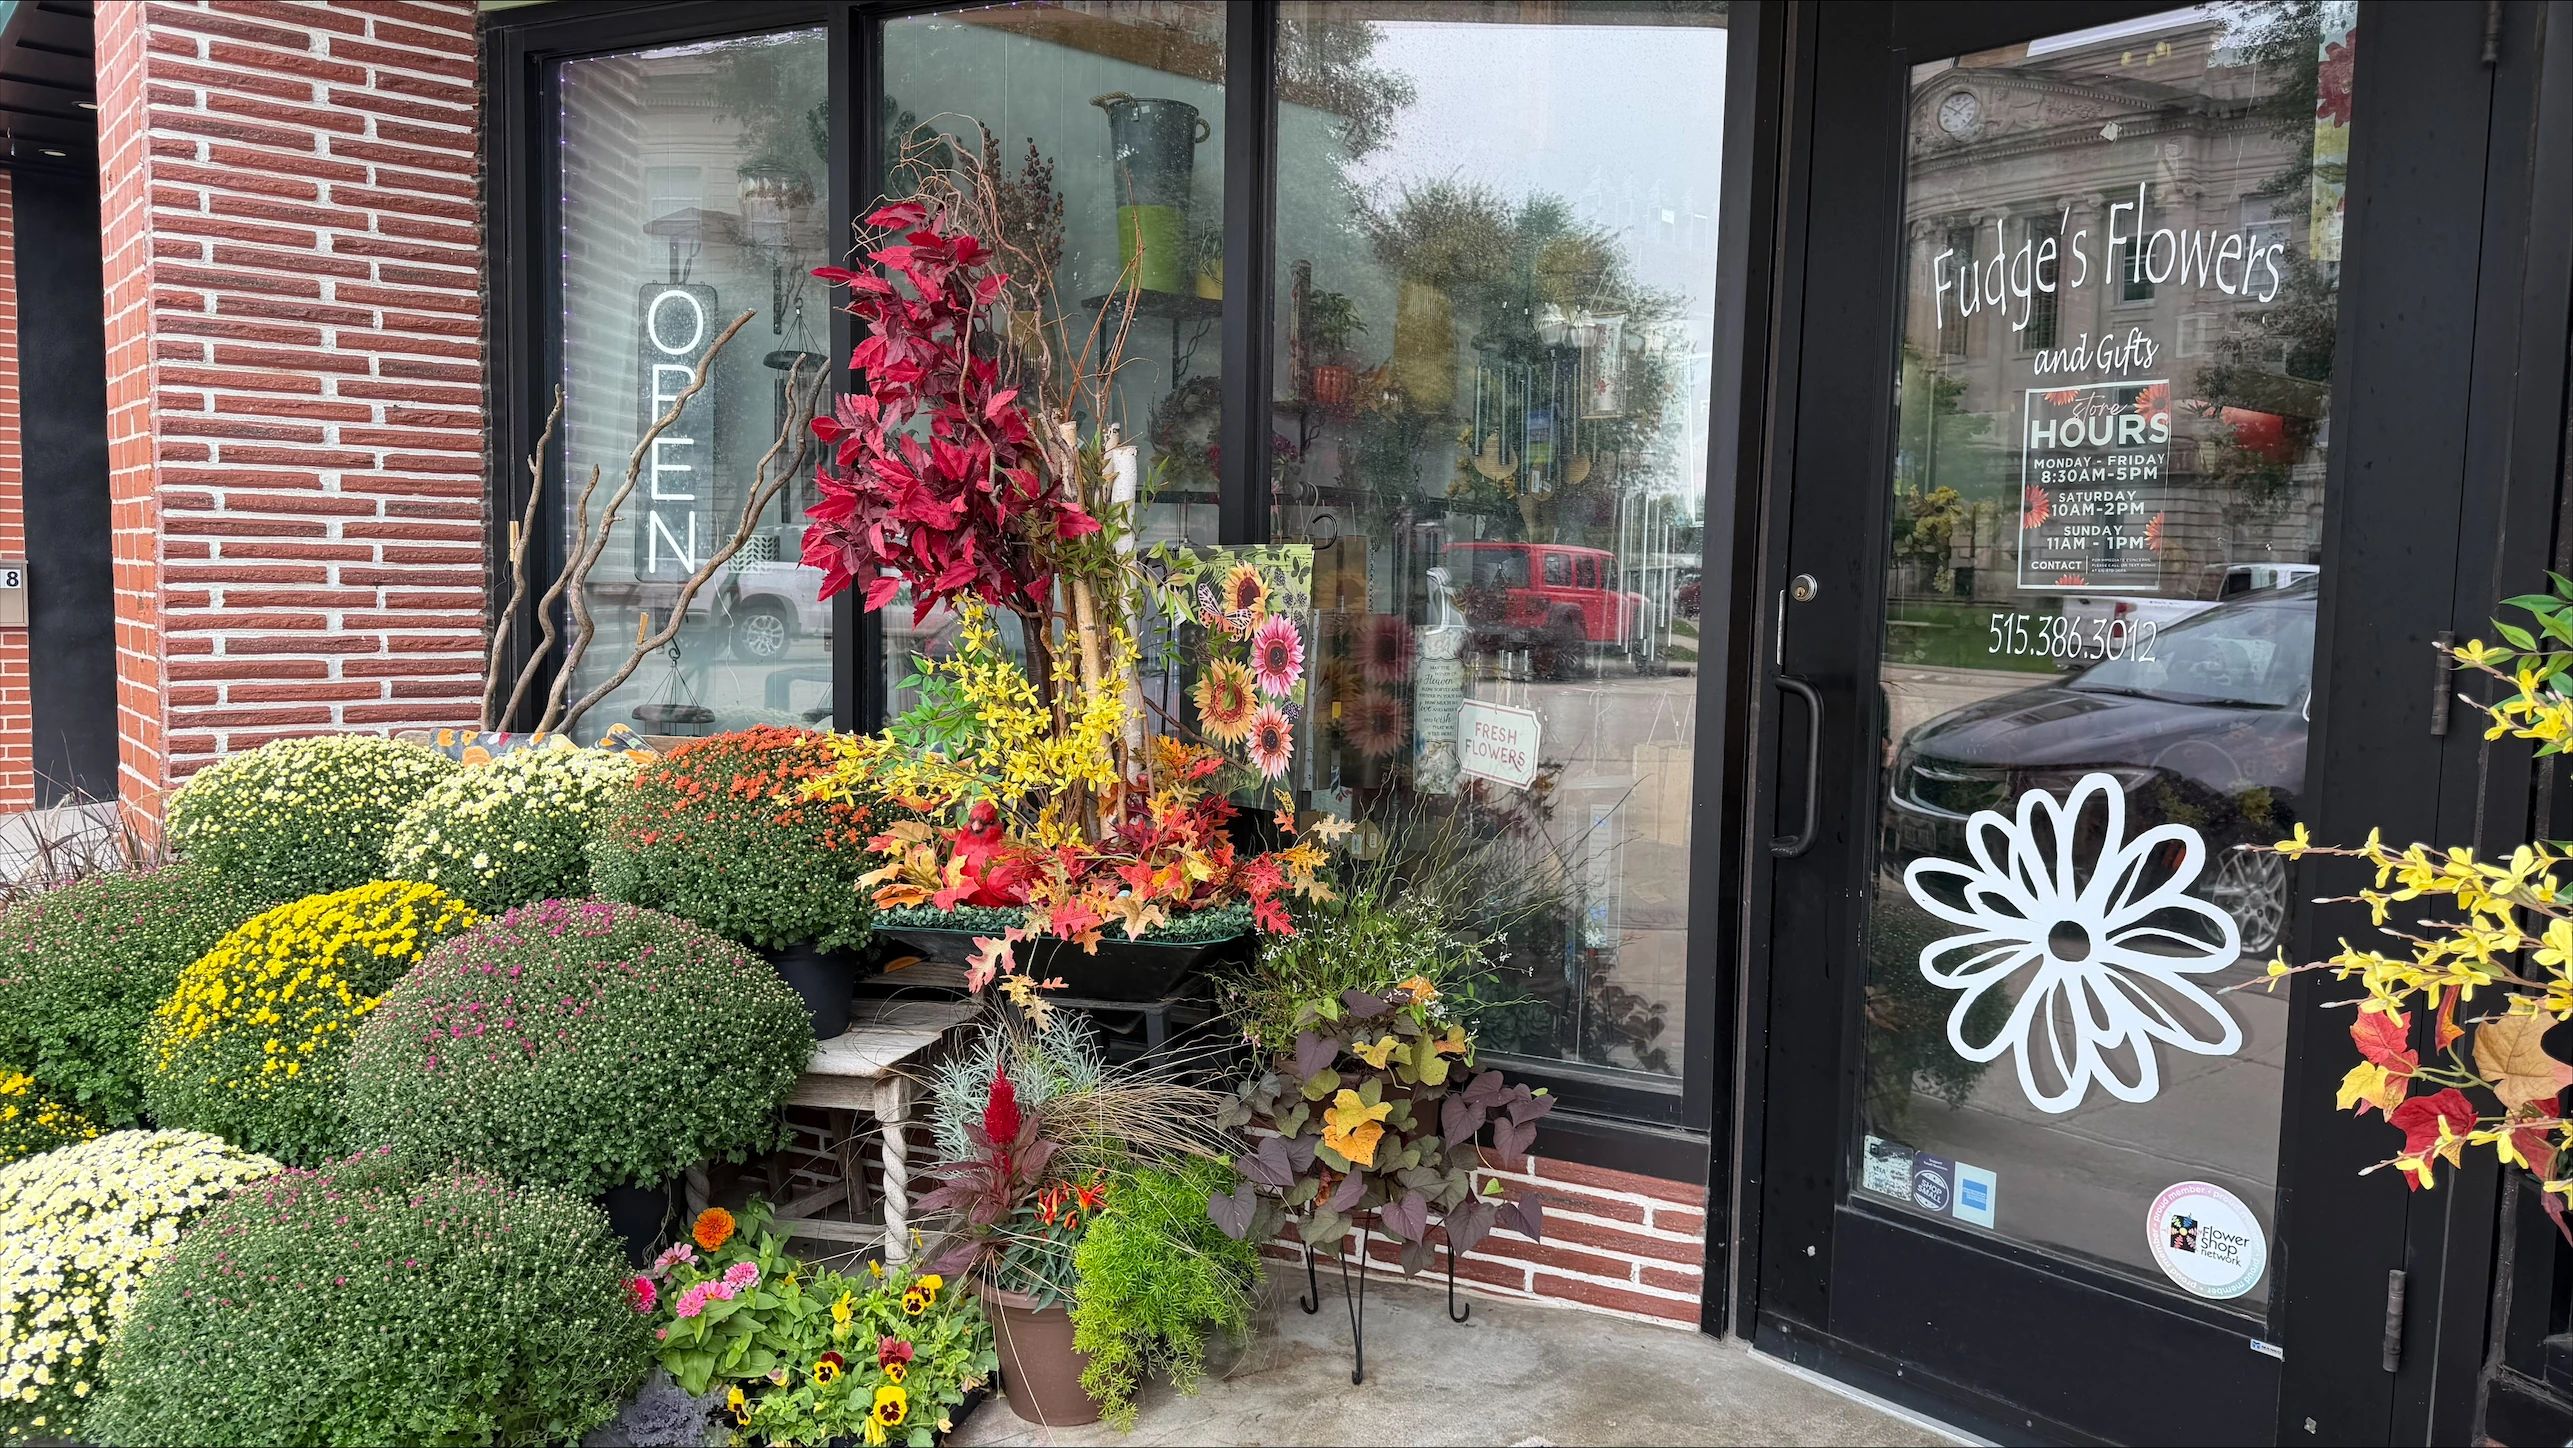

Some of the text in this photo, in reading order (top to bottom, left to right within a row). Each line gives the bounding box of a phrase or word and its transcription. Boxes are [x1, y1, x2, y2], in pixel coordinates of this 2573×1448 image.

[1934, 182, 2285, 332] Fudge's Flowers
[2034, 327, 2160, 376] and Gifts
[2072, 391, 2128, 424] store
[647, 289, 704, 575] OPEN
[2031, 412, 2169, 449] HOURS
[2034, 457, 2091, 469] MONDAY
[2107, 453, 2165, 466] FRIDAY
[2041, 466, 2158, 484] 8:30AM-5PM
[2059, 490, 2137, 503] SATURDAY
[2052, 502, 2145, 517] 10AM-2PM
[2064, 525, 2123, 536] SUNDAY
[2047, 537, 2086, 550] 11AM
[2107, 536, 2144, 550] 1PM
[2031, 561, 2082, 570] CONTACT
[6, 571, 19, 587] 8
[1989, 611, 2159, 664] 515.386.3012
[1474, 721, 1517, 744] FRESH
[1465, 739, 1526, 772] FLOWERS
[1917, 1184, 1942, 1204] SMALL
[1921, 1179, 1943, 1195] SHOP
[2153, 1184, 2206, 1223] proud member
[2201, 1237, 2238, 1256] Shop
[2202, 1226, 2250, 1248] Flower
[2201, 1249, 2242, 1267] network
